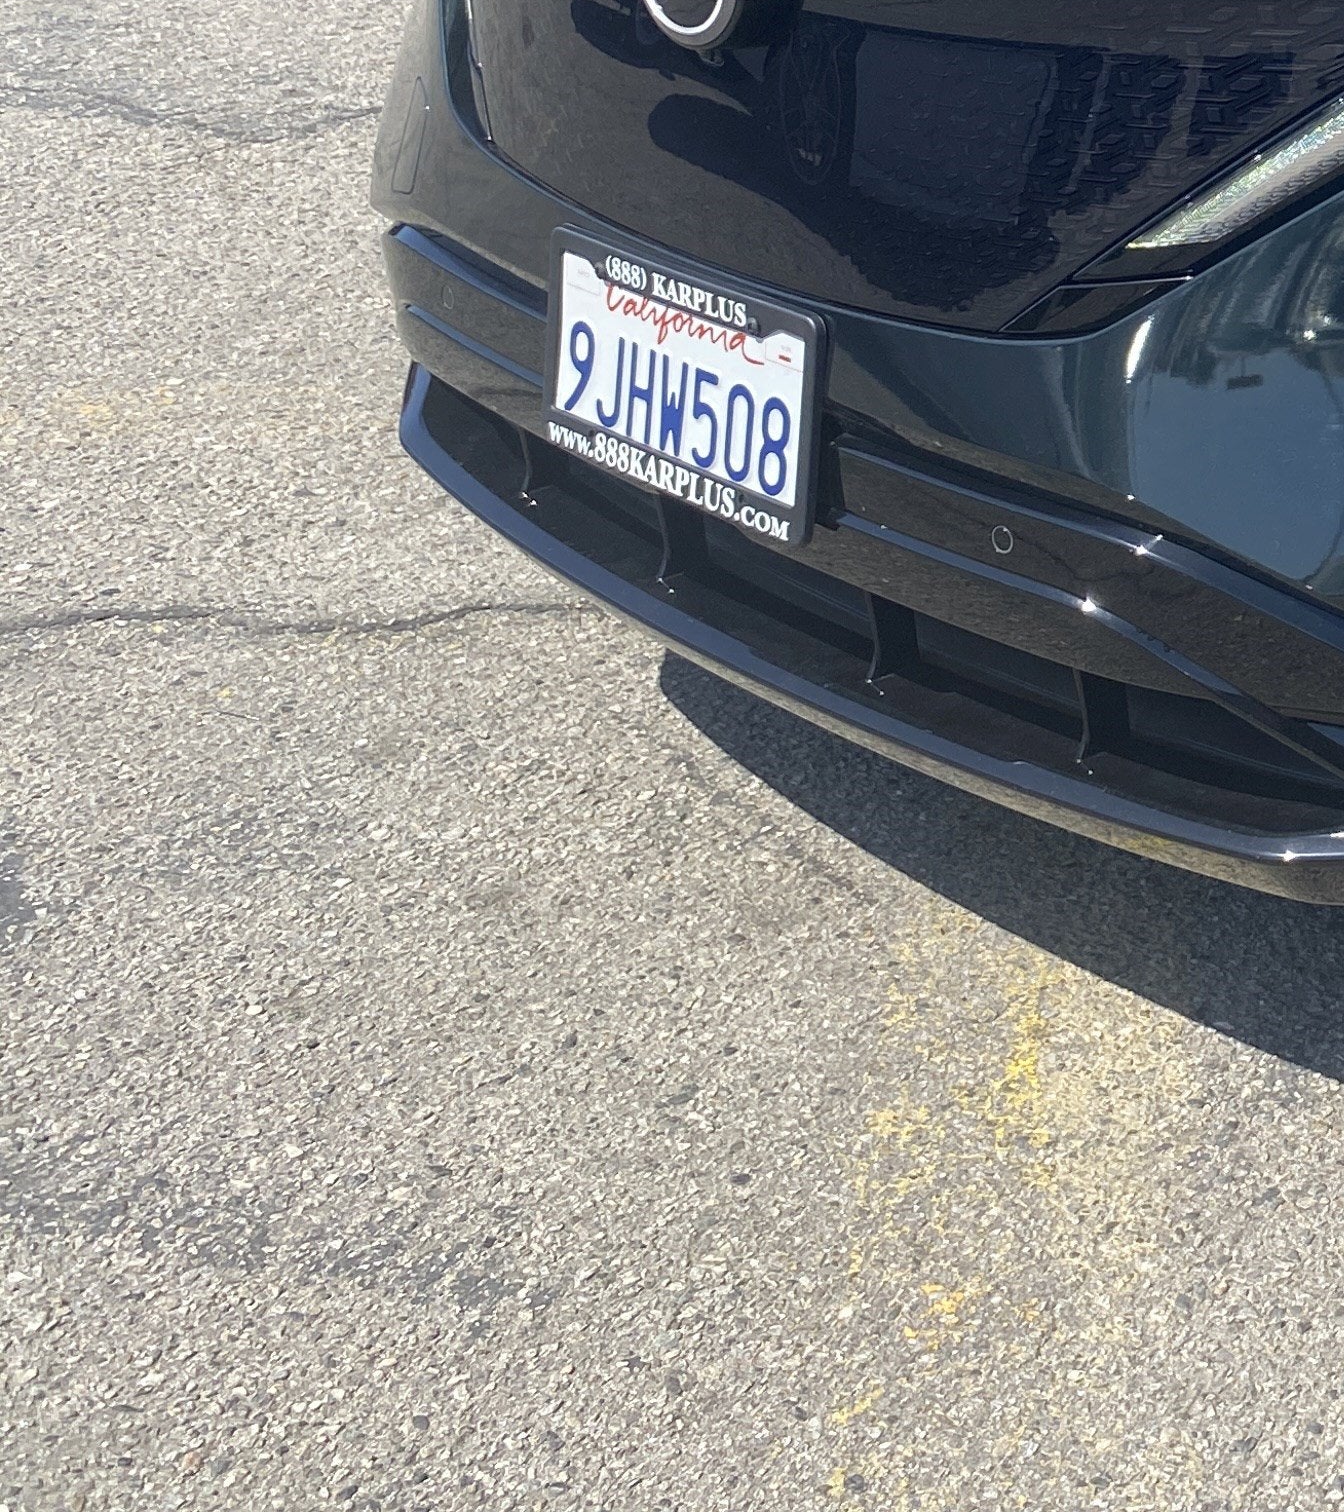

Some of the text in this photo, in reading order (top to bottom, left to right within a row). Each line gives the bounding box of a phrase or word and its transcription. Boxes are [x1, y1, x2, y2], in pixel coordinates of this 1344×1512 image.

[604, 283, 765, 366] California
[605, 254, 747, 327] (888) KARPLUS
[563, 320, 791, 497] 9JHW508
